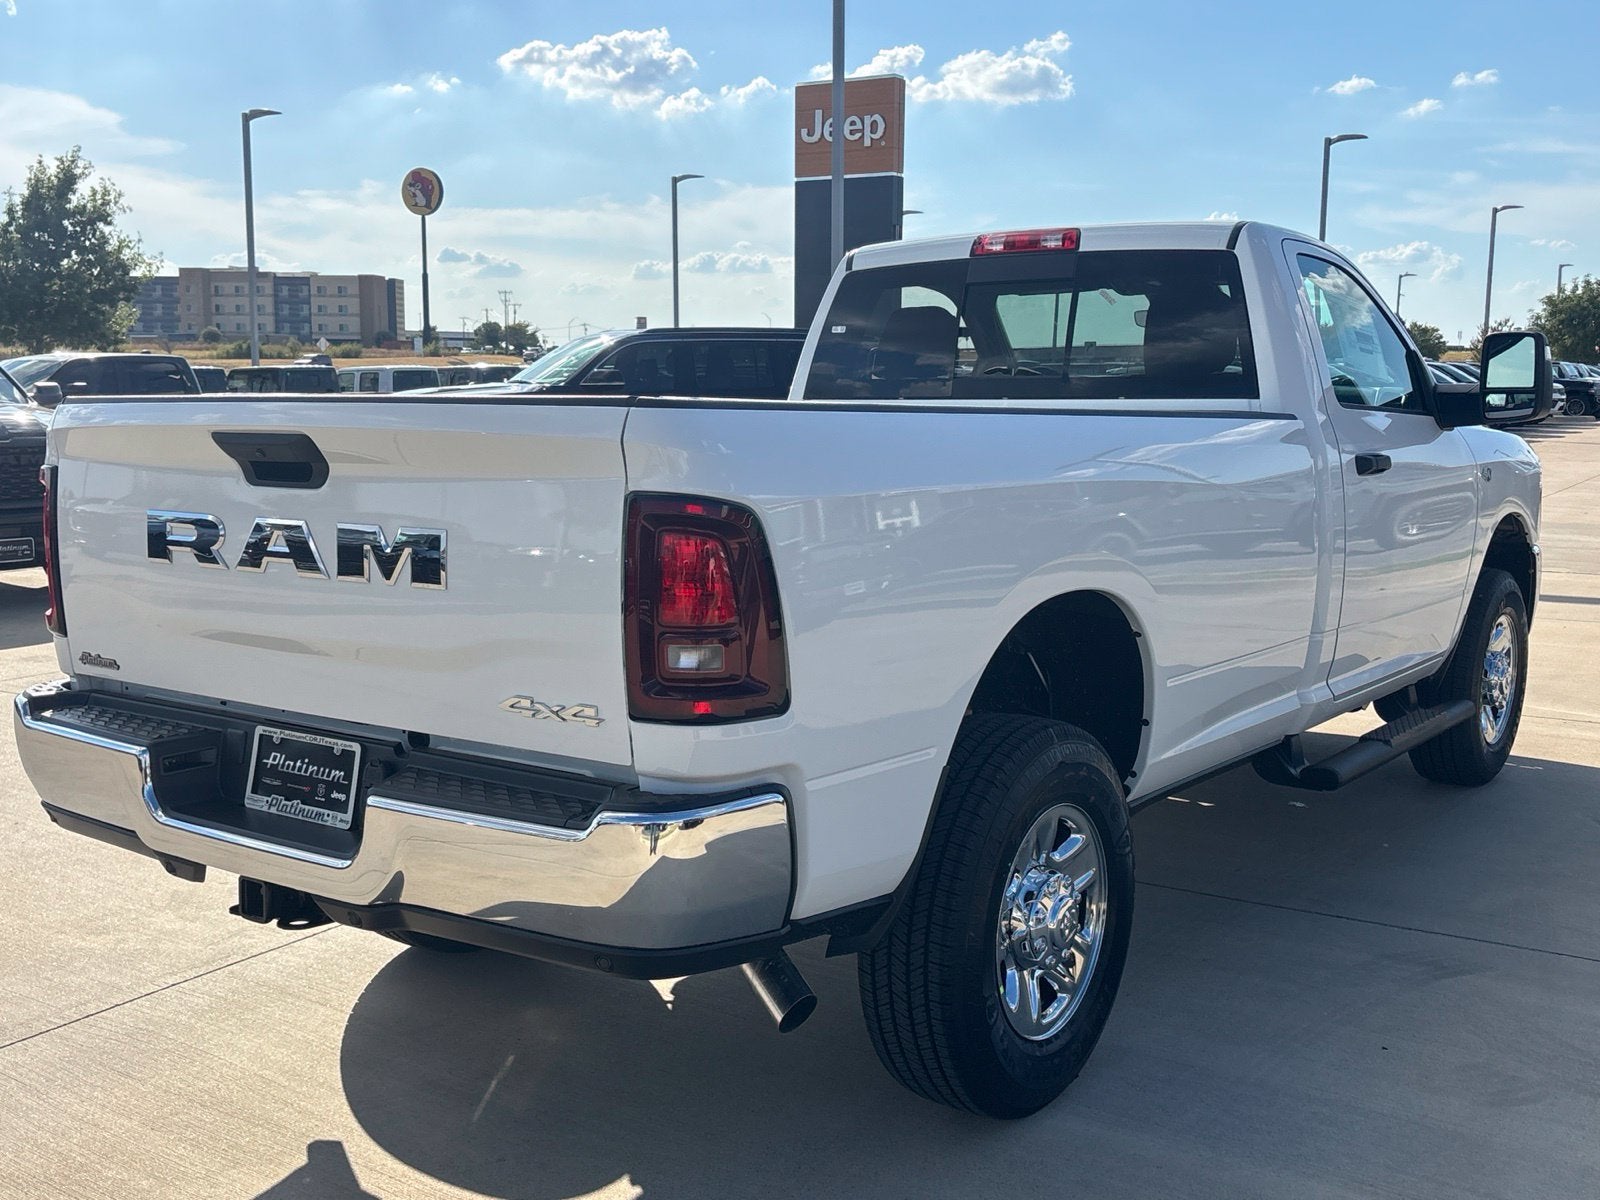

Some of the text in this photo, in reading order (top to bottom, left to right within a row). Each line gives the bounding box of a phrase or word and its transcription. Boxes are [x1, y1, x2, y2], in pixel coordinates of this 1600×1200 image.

[146, 509, 448, 590] RAM
[498, 695, 605, 727] 4x4
[262, 752, 349, 784] Platinum
[268, 796, 328, 822] Platinum
